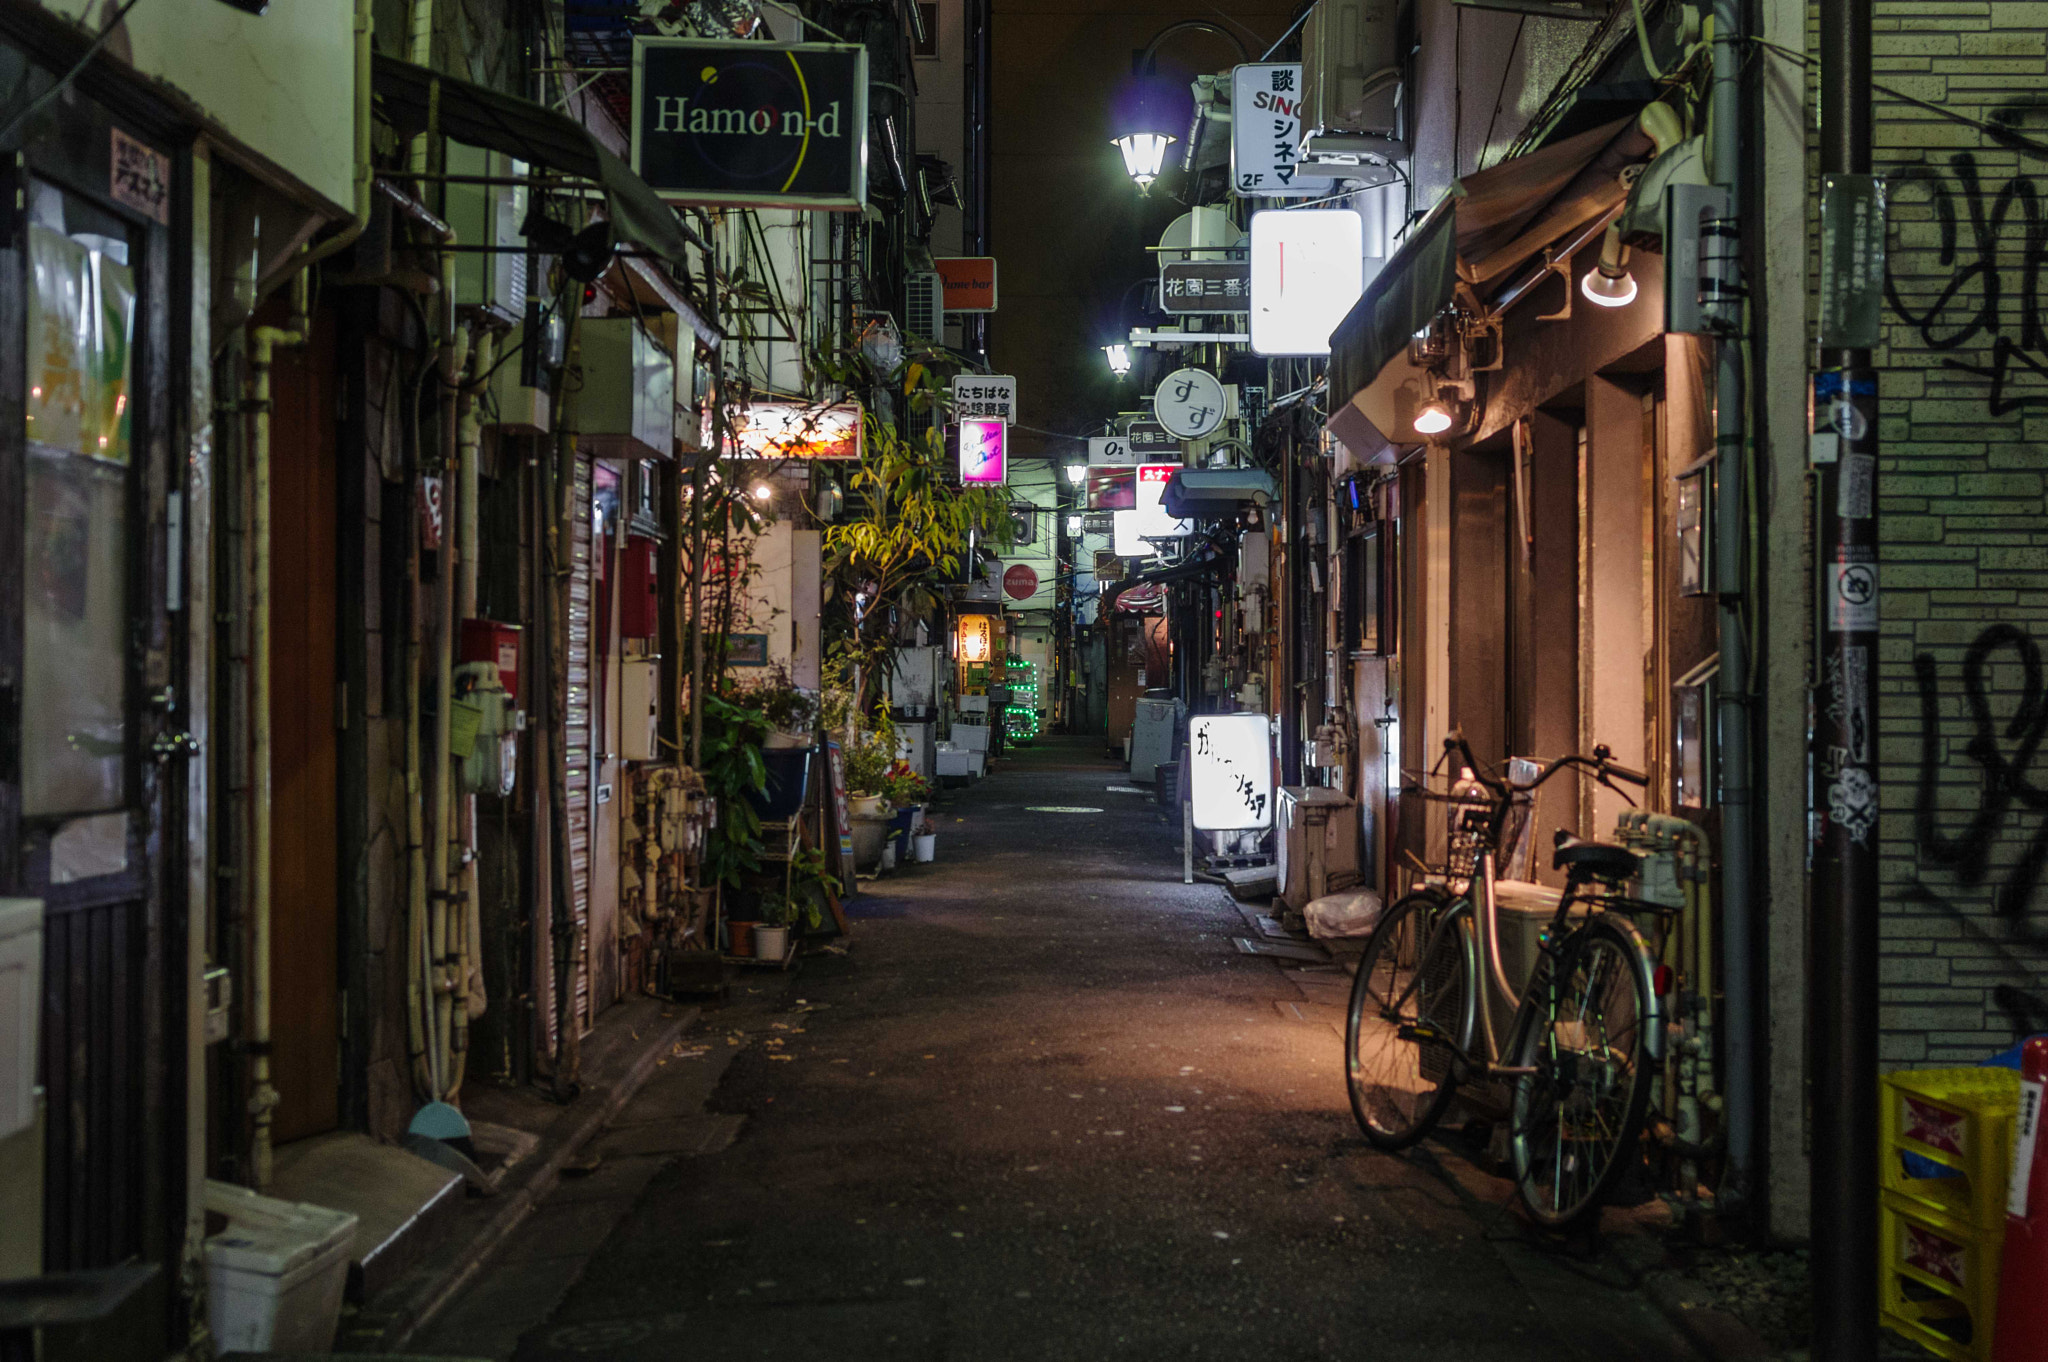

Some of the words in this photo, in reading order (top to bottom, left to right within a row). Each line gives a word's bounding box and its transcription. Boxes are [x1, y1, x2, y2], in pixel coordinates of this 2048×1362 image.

[1270, 69, 1295, 92] 談
[1273, 119, 1296, 186] シネマ
[1242, 173, 1265, 187] 2F
[972, 277, 993, 290] bar
[957, 386, 1010, 400] たちばな
[1006, 578, 1034, 586] zuma
